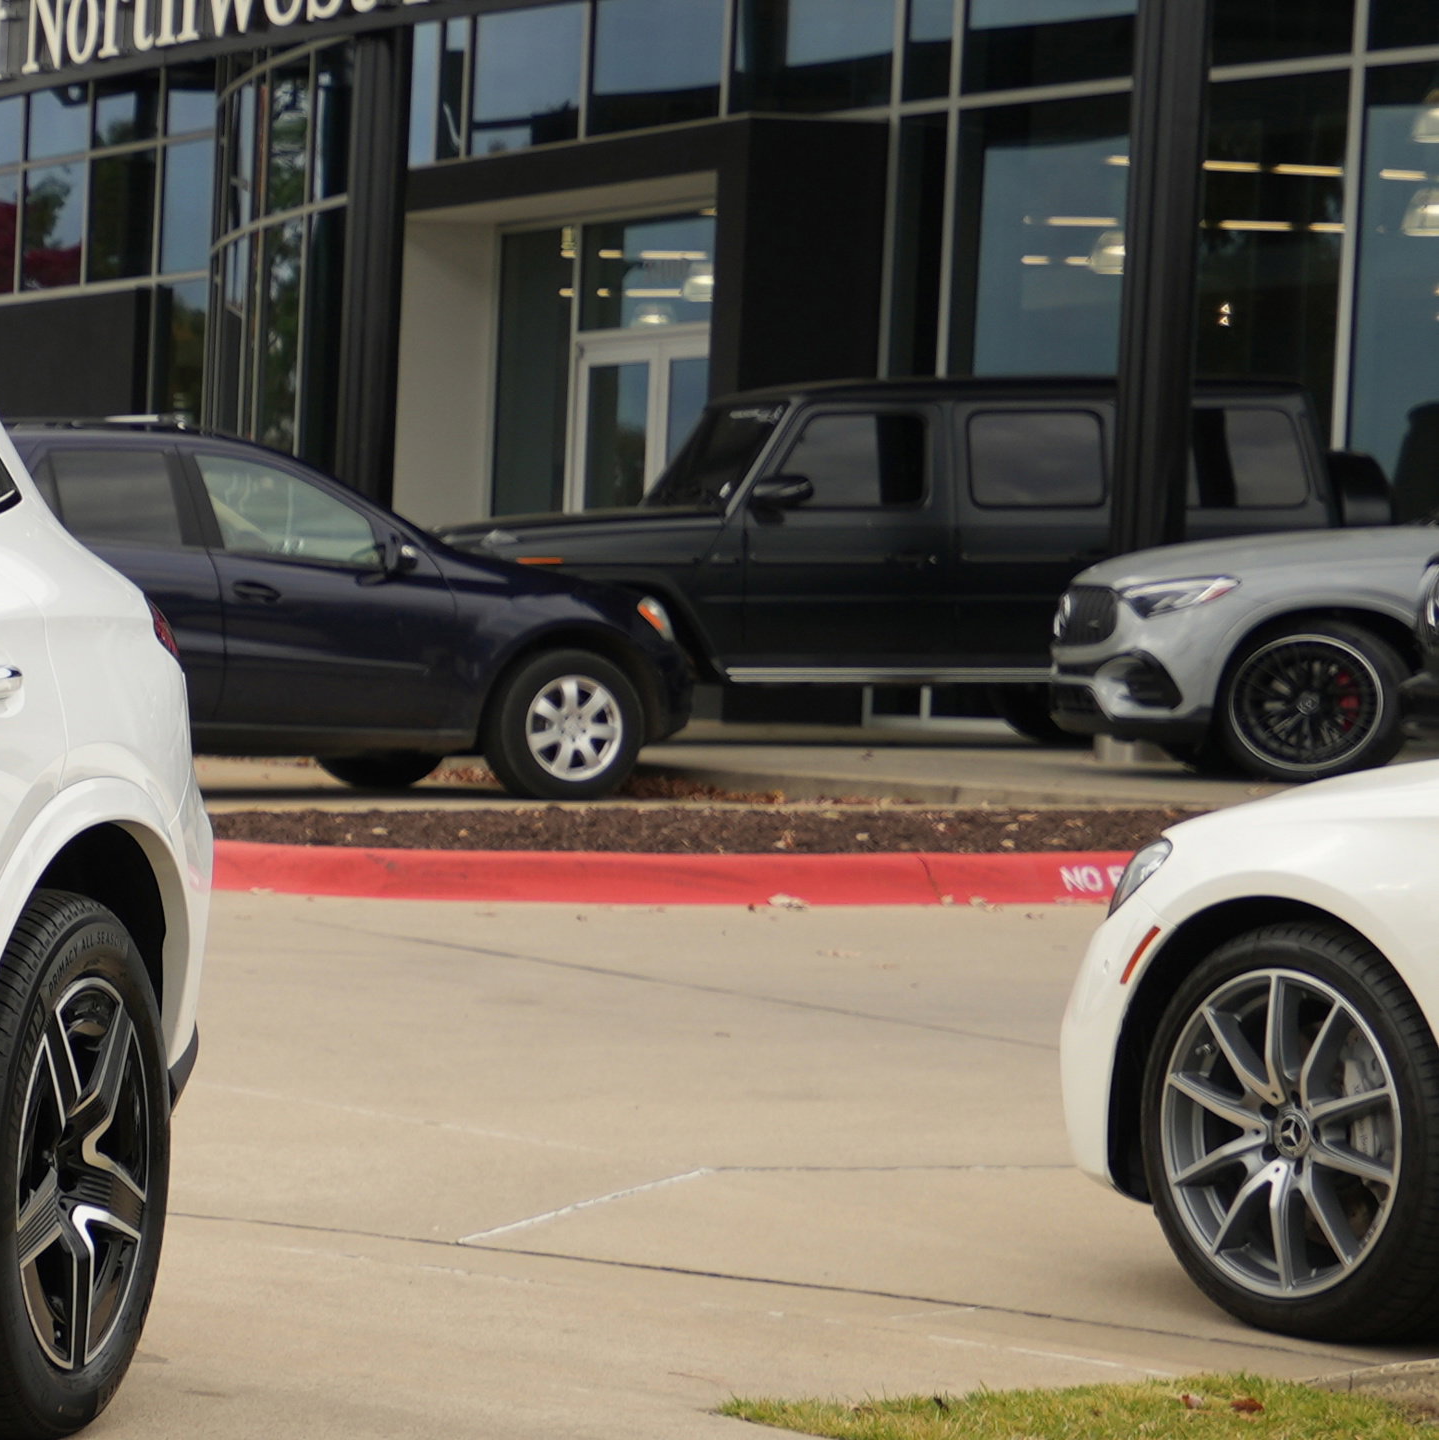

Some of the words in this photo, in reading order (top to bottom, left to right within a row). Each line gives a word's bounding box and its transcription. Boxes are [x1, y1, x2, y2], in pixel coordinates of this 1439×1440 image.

[1059, 866, 1104, 892] NO
[48, 942, 78, 997] PRIMACY
[81, 935, 94, 953] ALL
